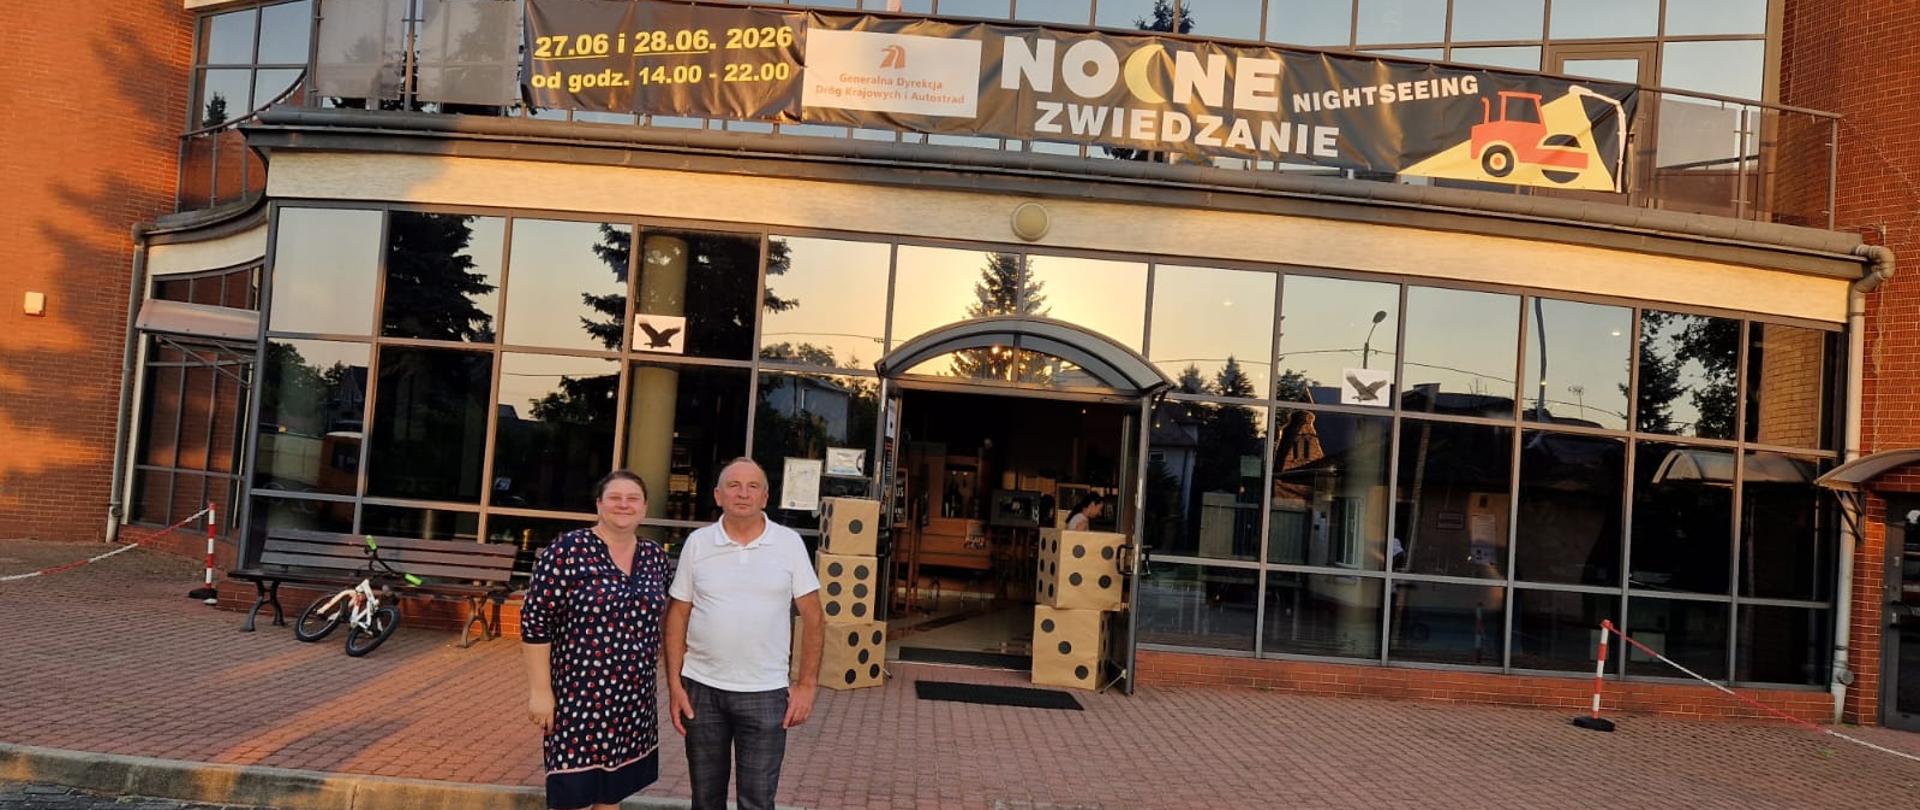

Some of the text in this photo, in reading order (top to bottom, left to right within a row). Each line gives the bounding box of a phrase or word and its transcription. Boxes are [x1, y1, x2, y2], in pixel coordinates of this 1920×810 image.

[534, 26, 793, 58] 27.06 i 28.06. 2026
[531, 71, 562, 89] od
[568, 69, 630, 93] godz.
[639, 65, 702, 86] 14.00
[723, 62, 790, 83] 22.00
[839, 73, 943, 91] Generalna Dyrekcja
[815, 85, 842, 97] Dróg
[845, 86, 901, 100] Krajowych
[911, 91, 965, 105] Autostrad
[1292, 75, 1480, 113] NIGHTSEEING
[1034, 101, 1340, 158] ZWIEDZANIE
